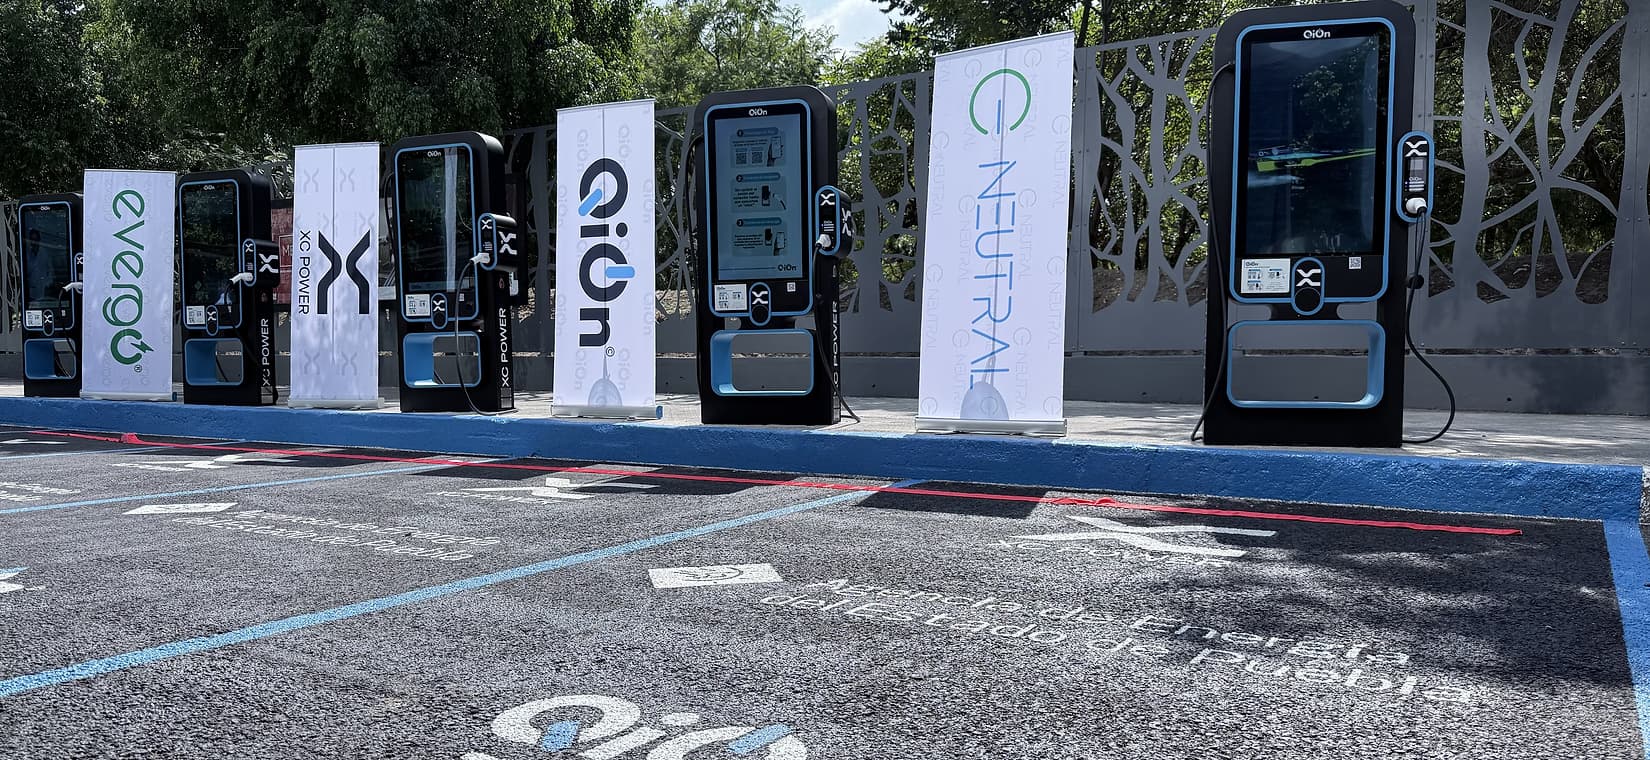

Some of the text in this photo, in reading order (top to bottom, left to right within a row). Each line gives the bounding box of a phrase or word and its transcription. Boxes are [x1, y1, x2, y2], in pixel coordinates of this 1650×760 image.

[1303, 28, 1331, 39] QiOn
[748, 107, 768, 116] QiOn
[103, 190, 153, 365] evergo
[298, 230, 311, 315] XC POWER
[578, 158, 635, 347] QiOn
[777, 263, 797, 272] QiOn
[970, 161, 1016, 390] NEUTRAL
[260, 318, 270, 365] POWER
[498, 307, 509, 387] XC POWER
[847, 602, 1068, 642] Estado
[1087, 637, 1170, 657] de
[1190, 648, 1474, 700] Puebla
